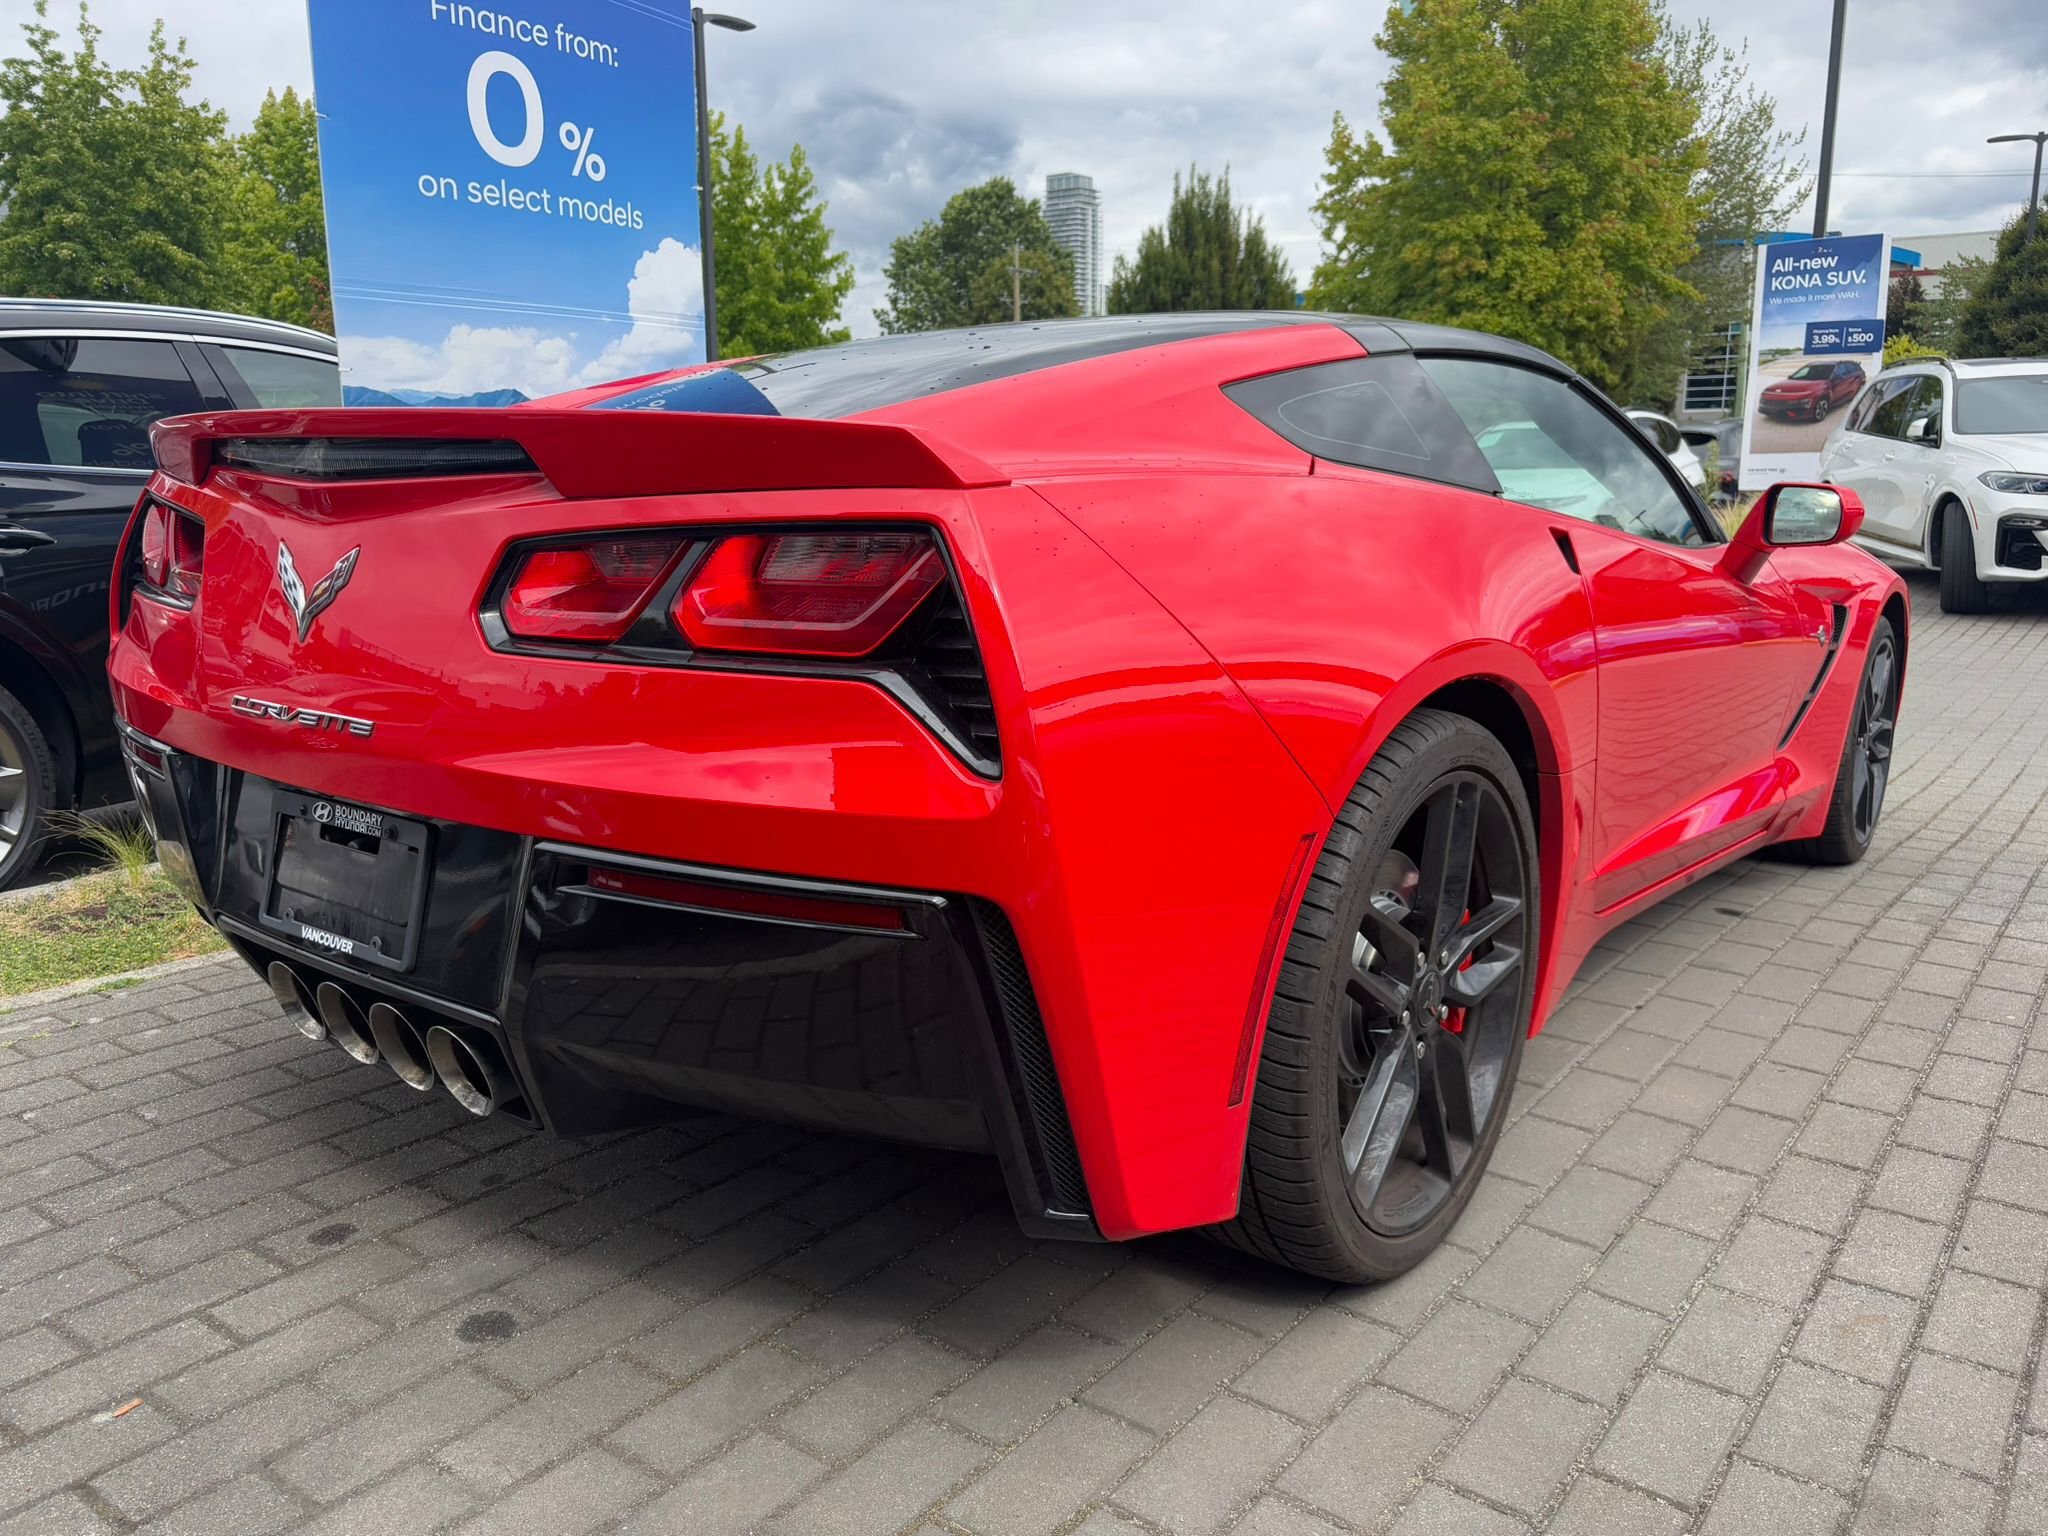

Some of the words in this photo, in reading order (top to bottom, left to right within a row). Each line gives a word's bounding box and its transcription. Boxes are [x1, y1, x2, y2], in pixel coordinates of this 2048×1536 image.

[431, 0, 549, 46] Finance
[555, 23, 619, 68] from:
[466, 50, 544, 168] 0
[559, 121, 607, 182] %
[417, 174, 458, 200] on
[467, 179, 552, 215] select
[558, 194, 644, 230] models
[1771, 255, 1839, 273] All-new
[1771, 273, 1823, 292] KONA
[1826, 269, 1867, 286] SUV.
[1769, 297, 1783, 305] We
[1783, 295, 1807, 304] made
[1807, 294, 1814, 302] it
[1814, 293, 1837, 302] more
[1812, 334, 1841, 344] 3.99%
[1847, 332, 1874, 343] $500
[230, 694, 375, 736] CORVETTE
[334, 804, 383, 827] BOUNDARY
[334, 817, 382, 837] HYUNDAI.COM
[301, 925, 353, 954] VANCOUVER
